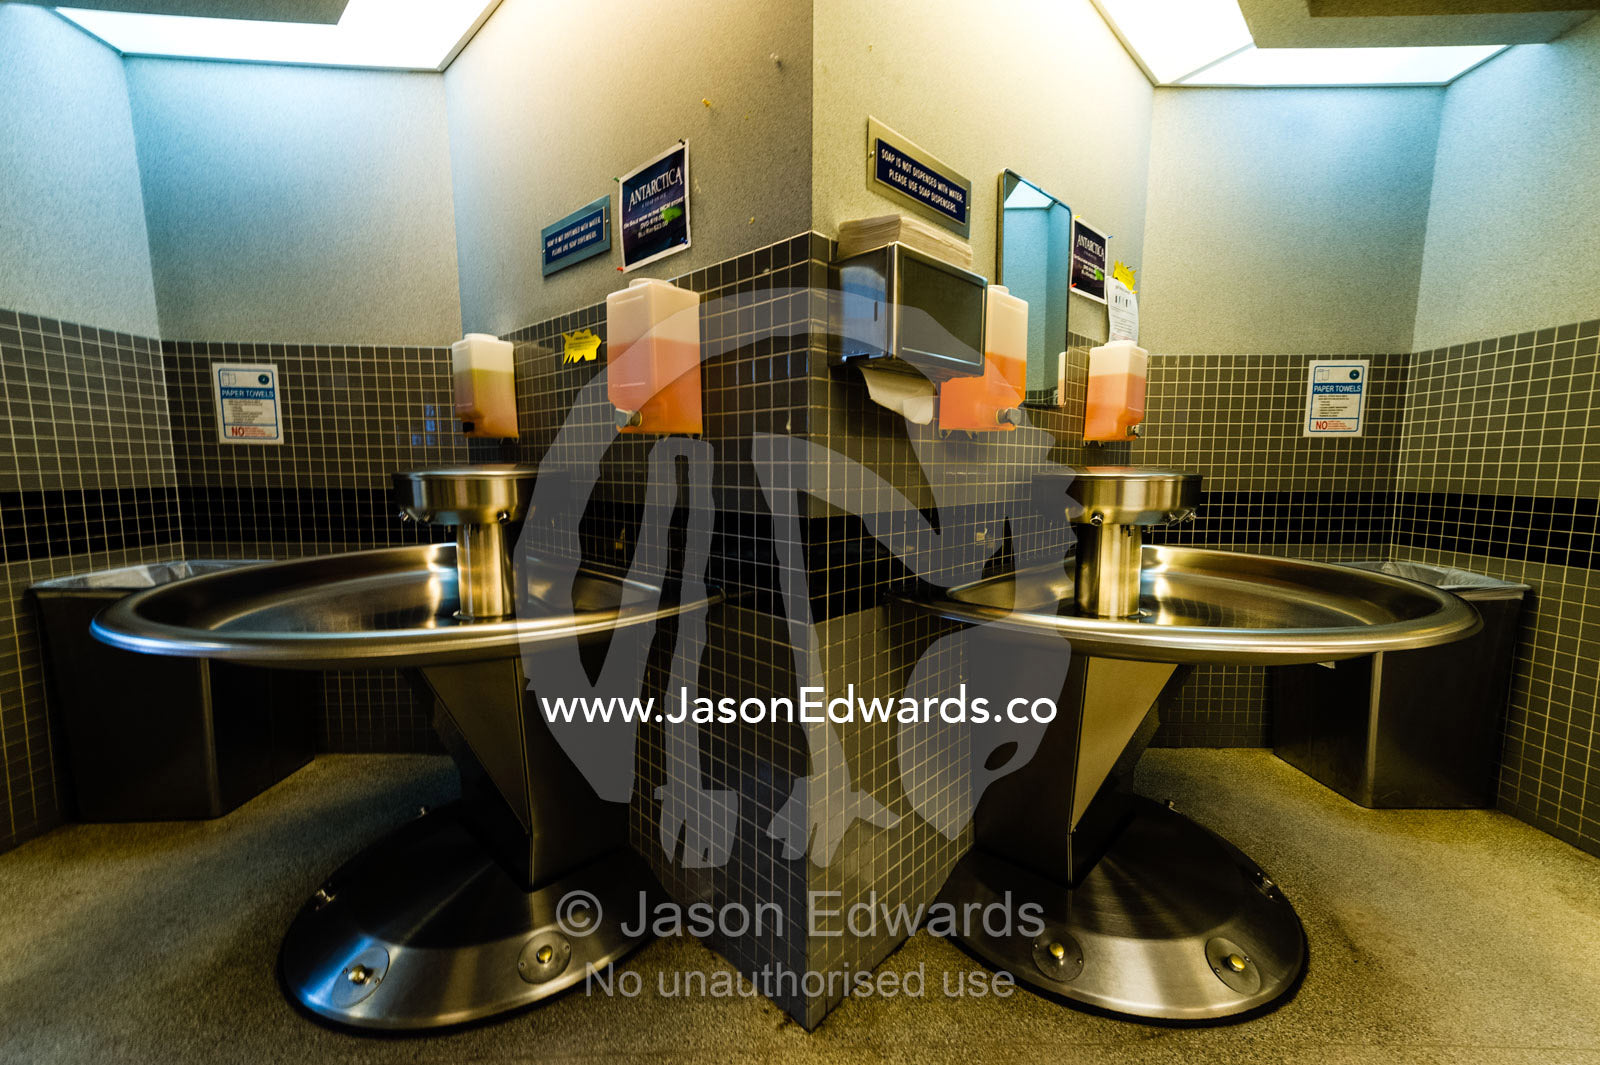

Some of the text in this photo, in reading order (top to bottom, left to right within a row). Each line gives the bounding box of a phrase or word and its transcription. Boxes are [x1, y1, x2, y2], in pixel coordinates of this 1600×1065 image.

[882, 149, 895, 164] SOAP
[896, 157, 901, 168] IS
[902, 161, 912, 173] NOT
[913, 167, 937, 188] DISPENSED
[938, 182, 948, 194] WITH
[629, 166, 683, 211] ANTARCTICA
[889, 169, 908, 186] PLEASE
[908, 179, 918, 192] USE
[919, 185, 930, 198] SOAP
[1077, 234, 1104, 261] ANTARCTICA
[246, 390, 274, 398] TOWELS
[1314, 385, 1361, 393] PAPER TOWELS
[232, 427, 245, 437] NO
[1316, 421, 1328, 430] NO
